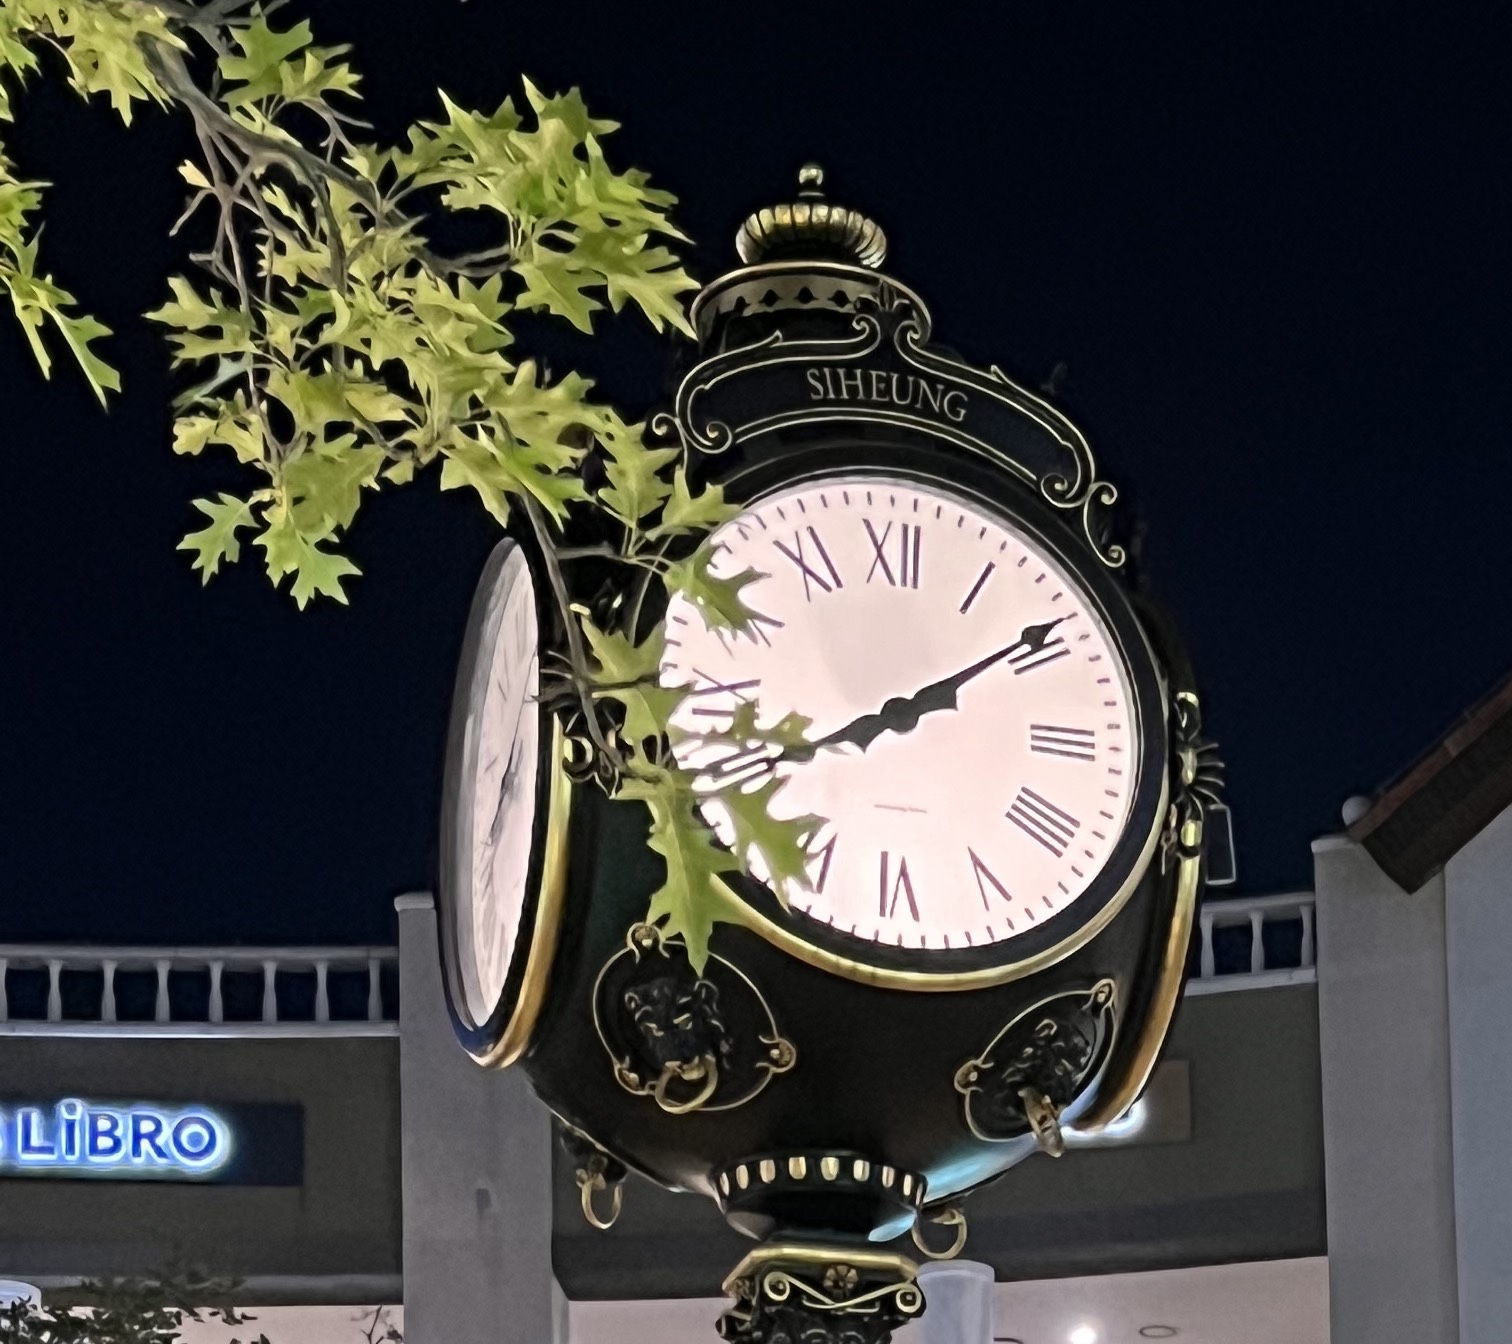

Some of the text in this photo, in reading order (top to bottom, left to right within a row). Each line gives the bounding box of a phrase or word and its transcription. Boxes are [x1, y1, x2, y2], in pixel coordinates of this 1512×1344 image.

[806, 367, 969, 422] SIHEUNG
[772, 525, 843, 602] XI
[862, 518, 921, 589] XII
